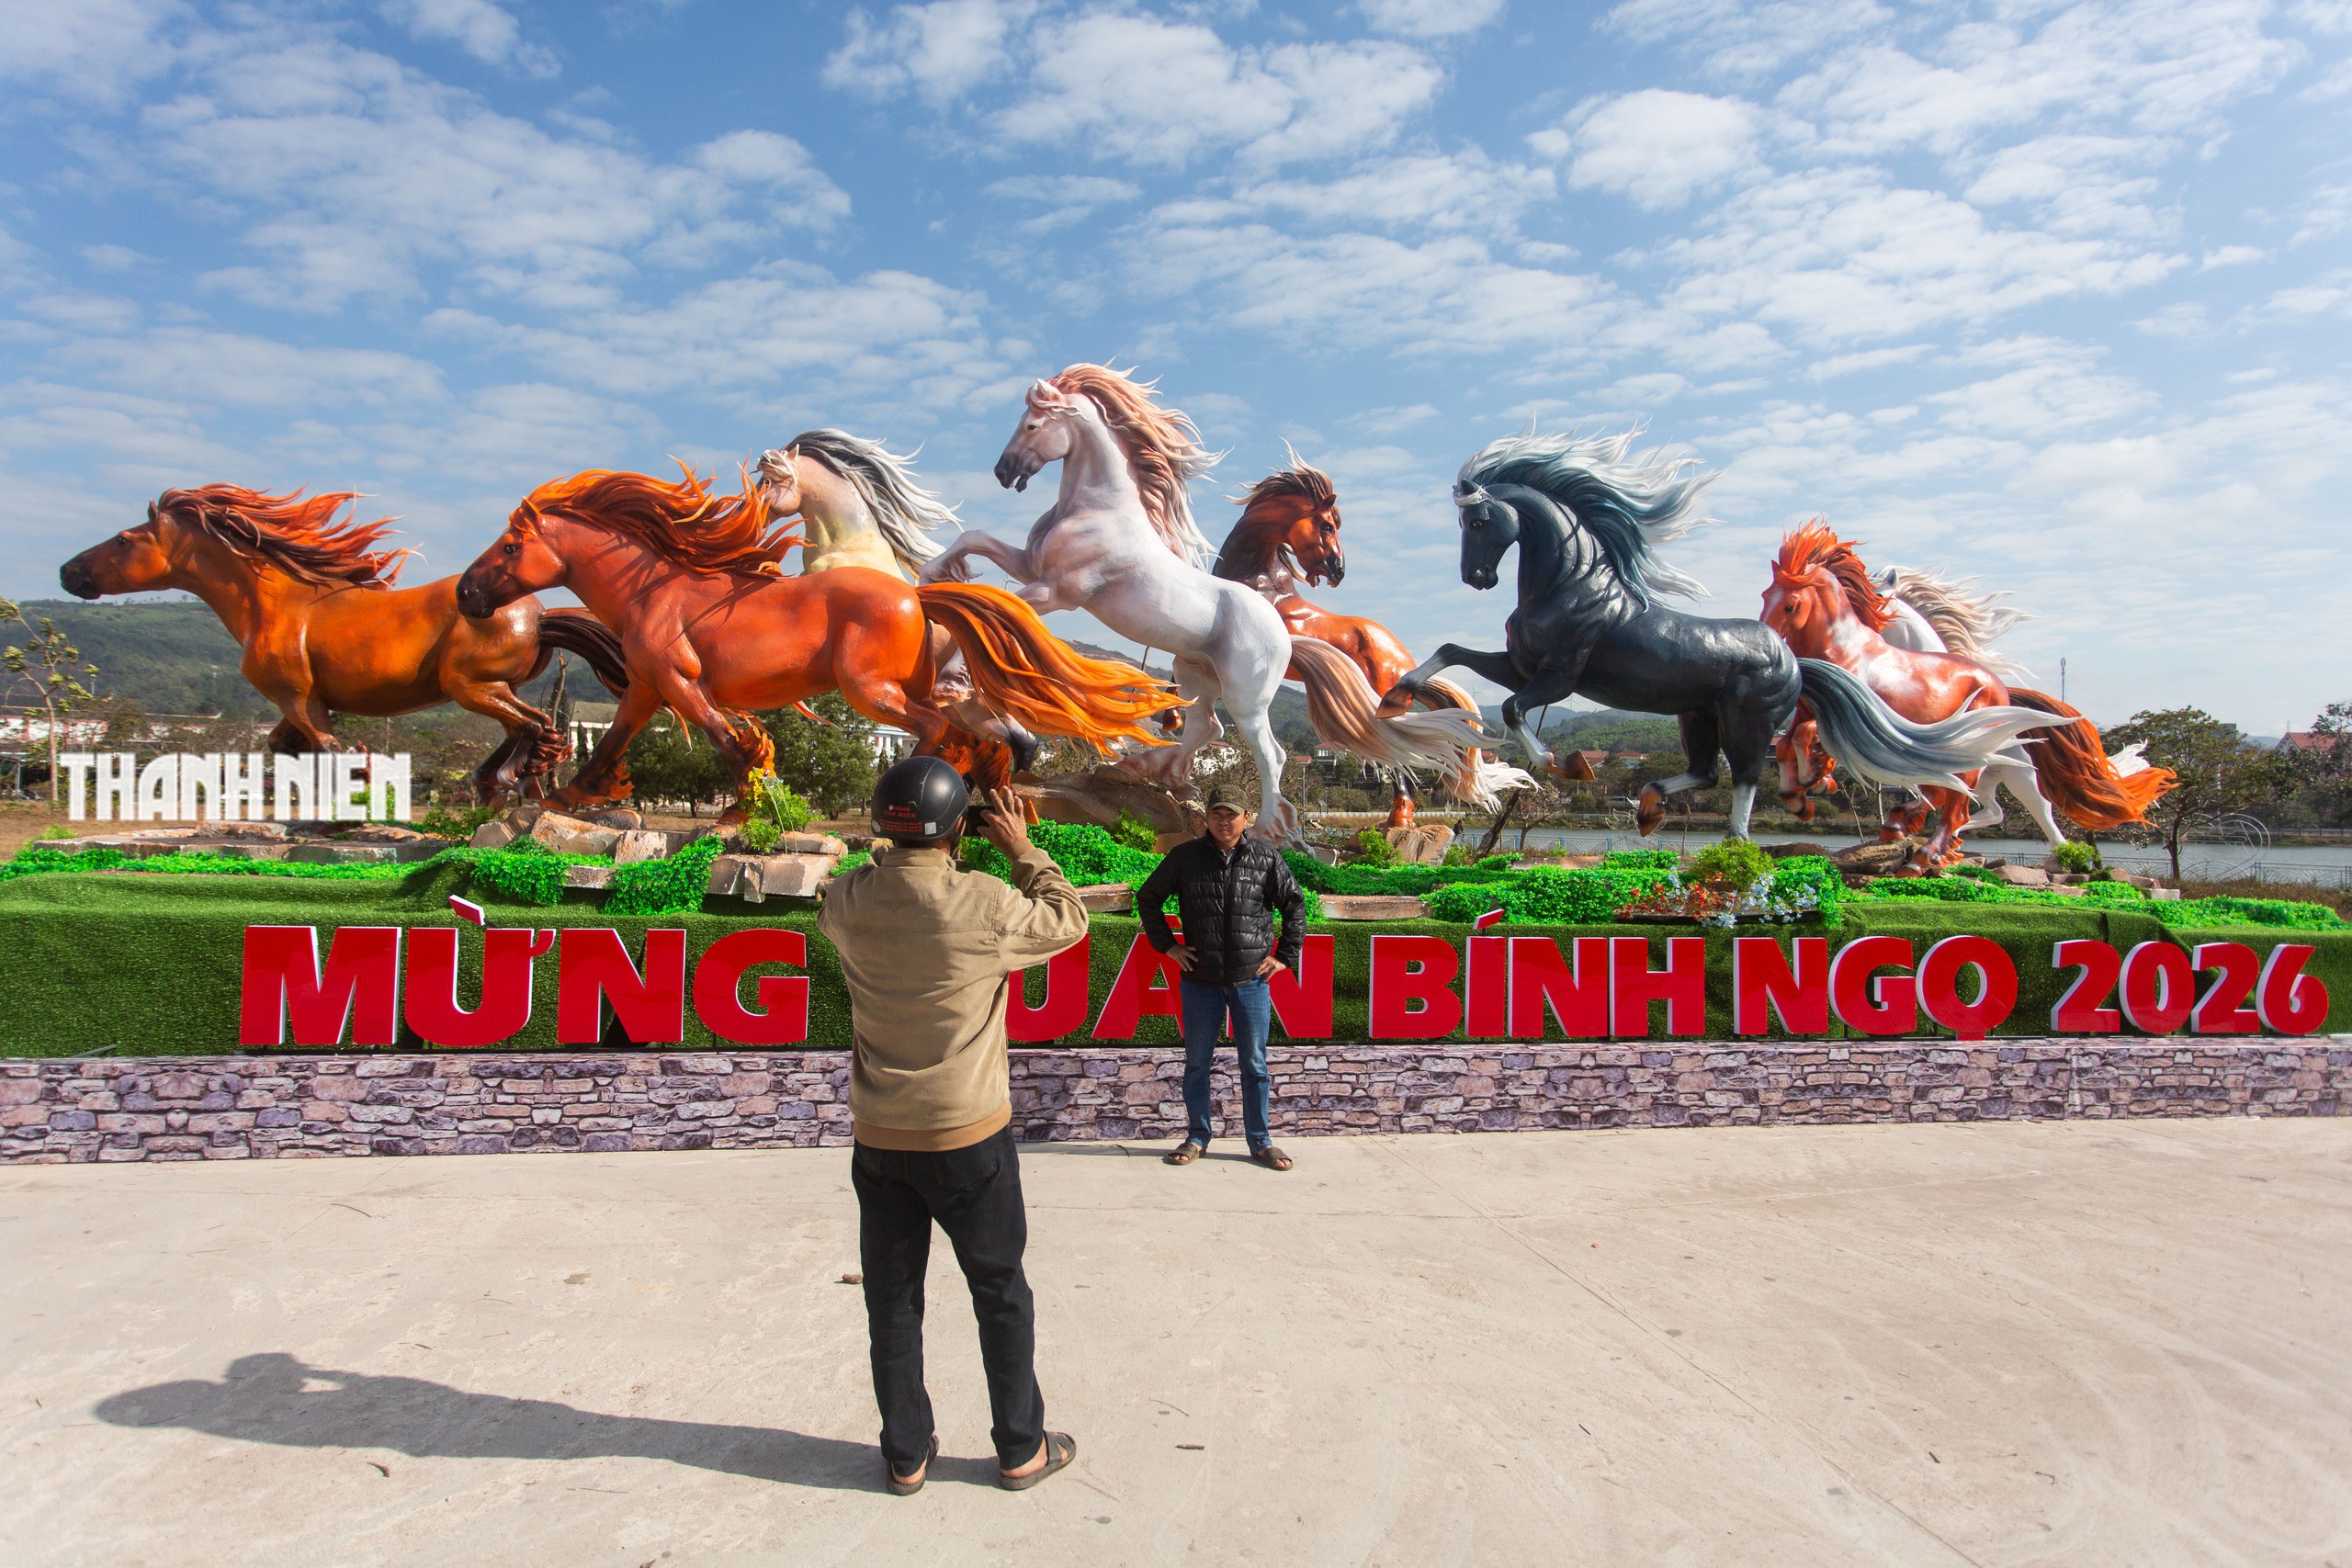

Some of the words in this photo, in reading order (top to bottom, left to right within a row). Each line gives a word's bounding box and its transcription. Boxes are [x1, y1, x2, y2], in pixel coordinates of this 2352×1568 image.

[239, 894, 810, 1047] MỪNG
[1005, 913, 1335, 1043] UÂN
[1368, 908, 1706, 1040] BÍNH
[1733, 935, 2018, 1042] NGỌ
[2050, 939, 2330, 1036] 2026
